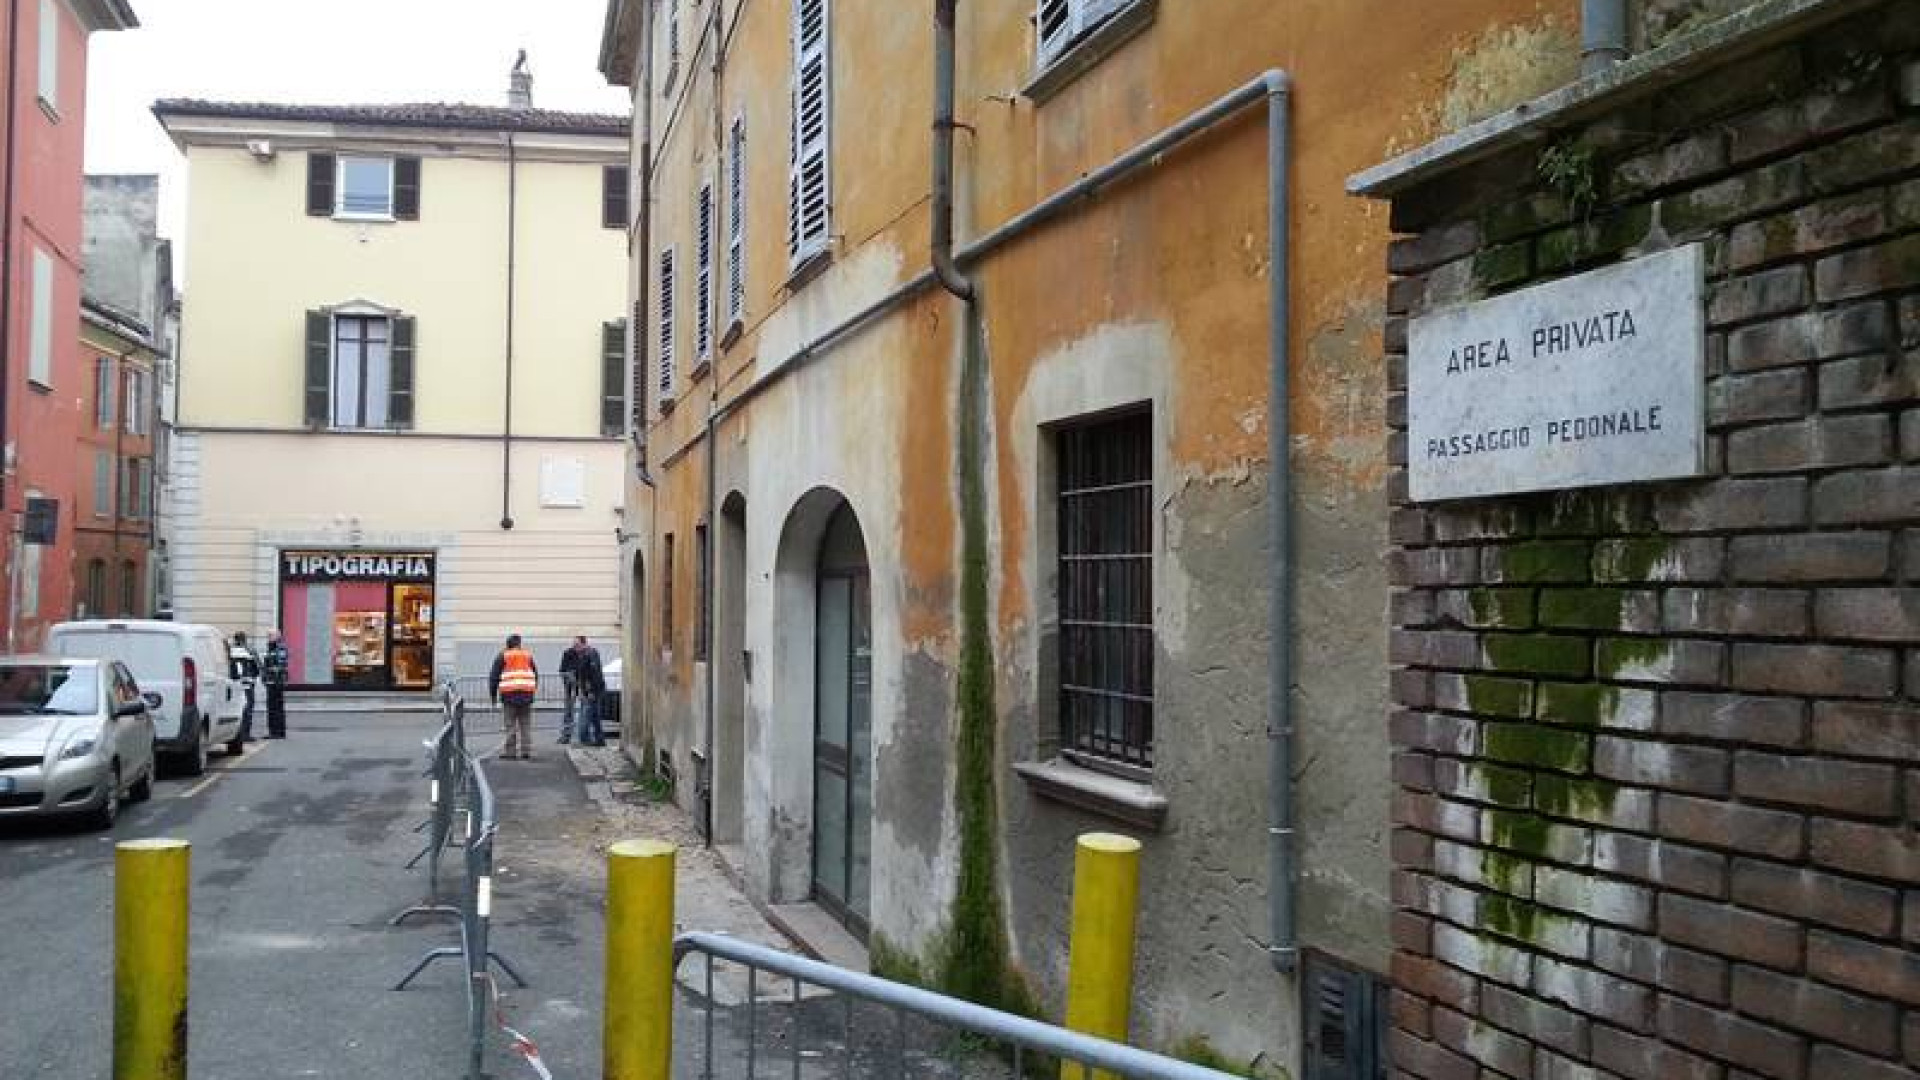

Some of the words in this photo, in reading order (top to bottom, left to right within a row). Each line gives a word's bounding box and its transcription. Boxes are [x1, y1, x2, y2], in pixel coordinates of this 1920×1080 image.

[1447, 338, 1510, 375] AREA
[1533, 309, 1635, 358] PRIVATA
[1428, 426, 1530, 459] PASSAGGIO
[1548, 405, 1661, 444] PEDONALE
[286, 556, 428, 575] TIPOGRAFIA
